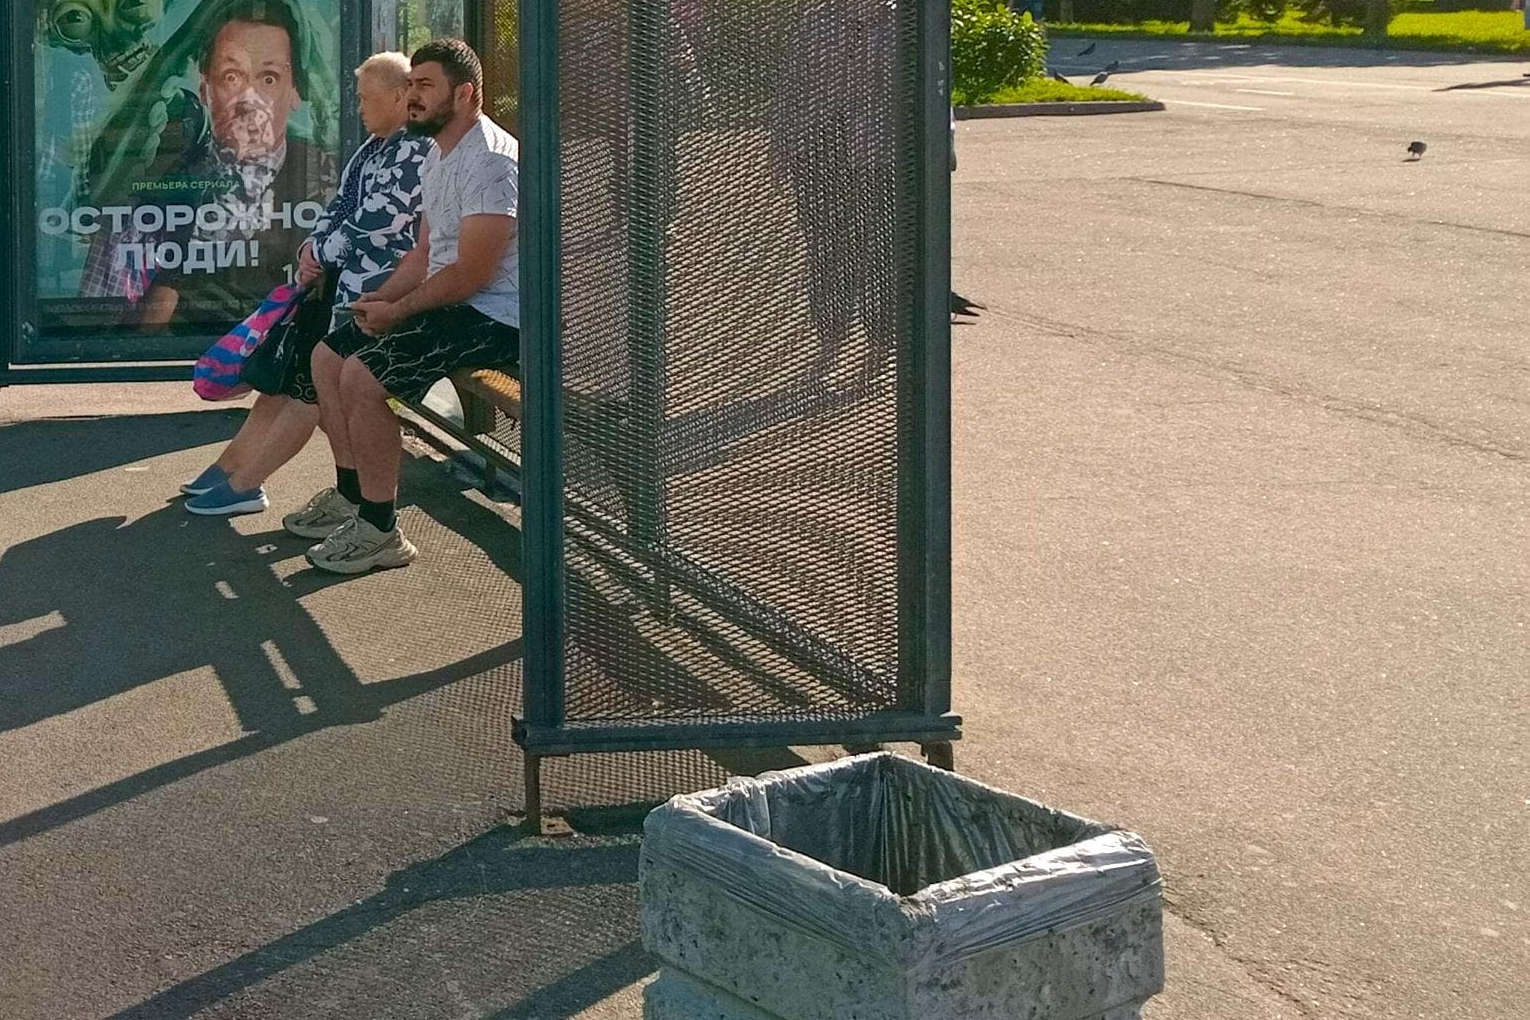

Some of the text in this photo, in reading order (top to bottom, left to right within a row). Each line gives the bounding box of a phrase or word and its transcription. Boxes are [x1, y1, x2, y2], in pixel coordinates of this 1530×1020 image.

[132, 180, 240, 190] ПРЕМЬЕРА СЕРИАЛА
[38, 201, 324, 236] ОСТОРОЖНО
[116, 240, 260, 274] ЛЮДИ!
